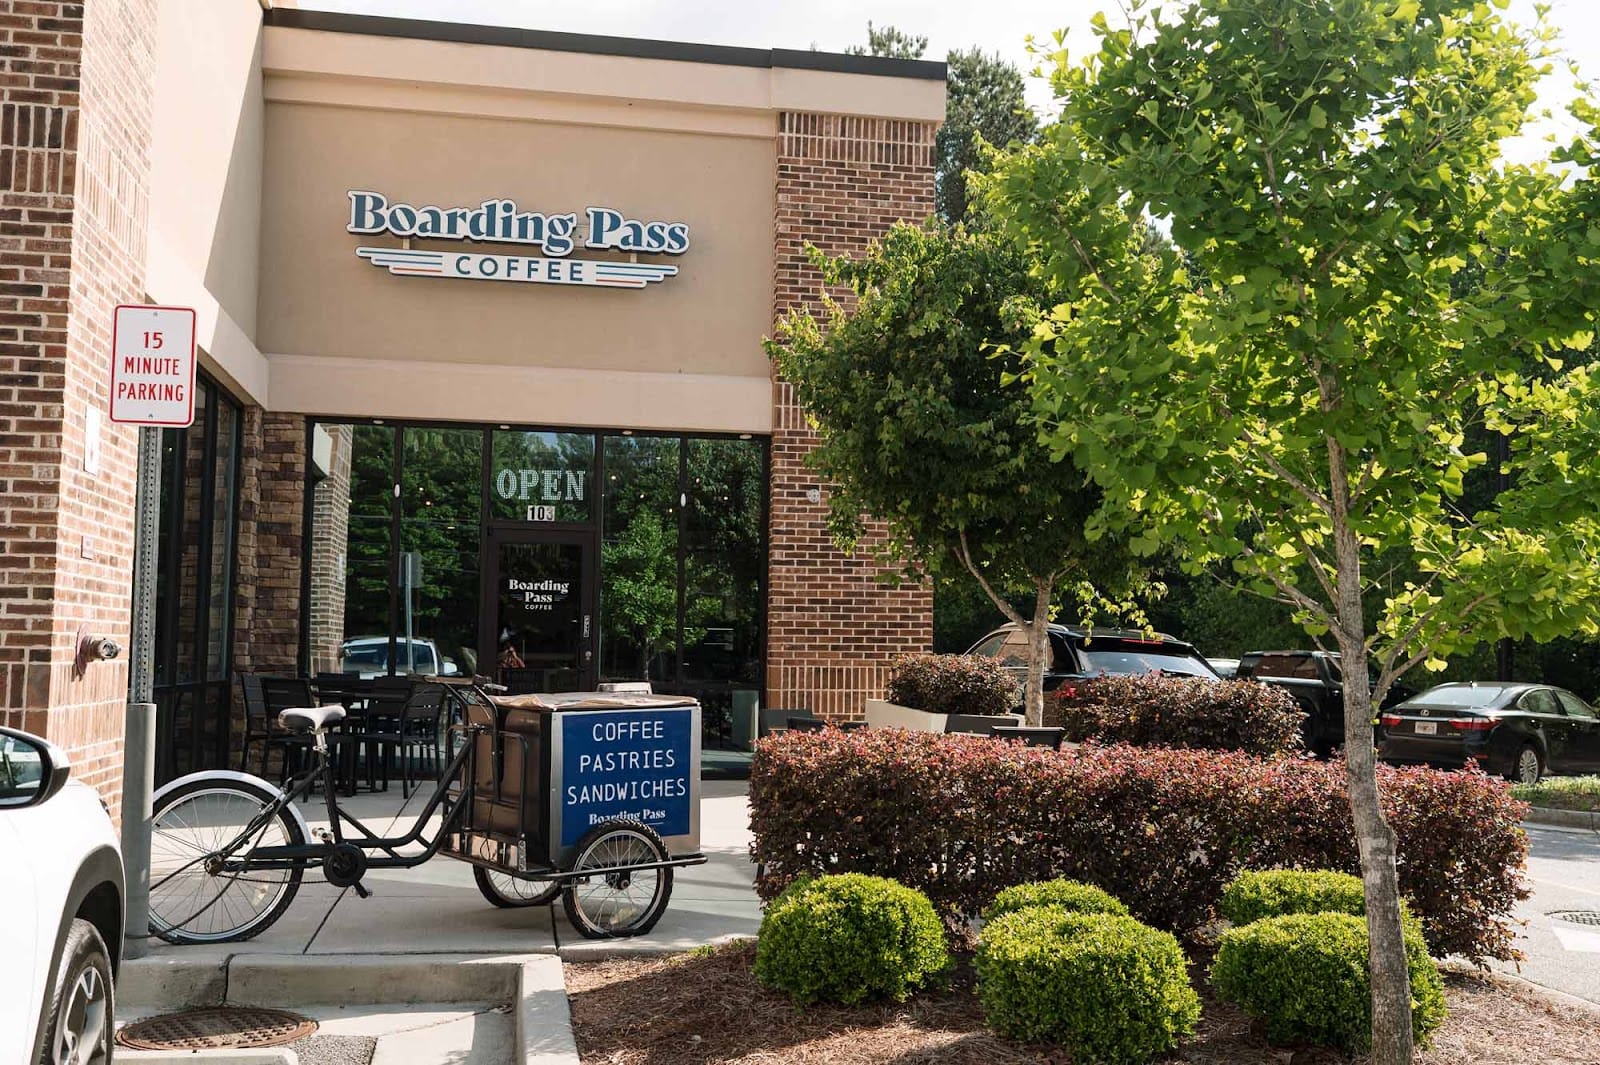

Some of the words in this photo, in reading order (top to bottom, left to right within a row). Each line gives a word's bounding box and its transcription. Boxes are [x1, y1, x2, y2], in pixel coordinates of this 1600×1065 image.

[348, 191, 576, 256] Boarding
[586, 207, 689, 254] Pass
[455, 255, 583, 282] COFFEE
[143, 331, 164, 349] 15
[124, 356, 180, 376] MINUTE
[118, 382, 184, 402] PARKING
[496, 468, 586, 500] OPEN
[529, 506, 554, 520] 103
[509, 579, 570, 594] Boarding
[525, 591, 553, 602] Pass
[592, 720, 665, 742] COFFEE
[579, 749, 676, 774] PASTRIES
[567, 778, 686, 805] SANDWICHES
[642, 808, 666, 820] Pass
